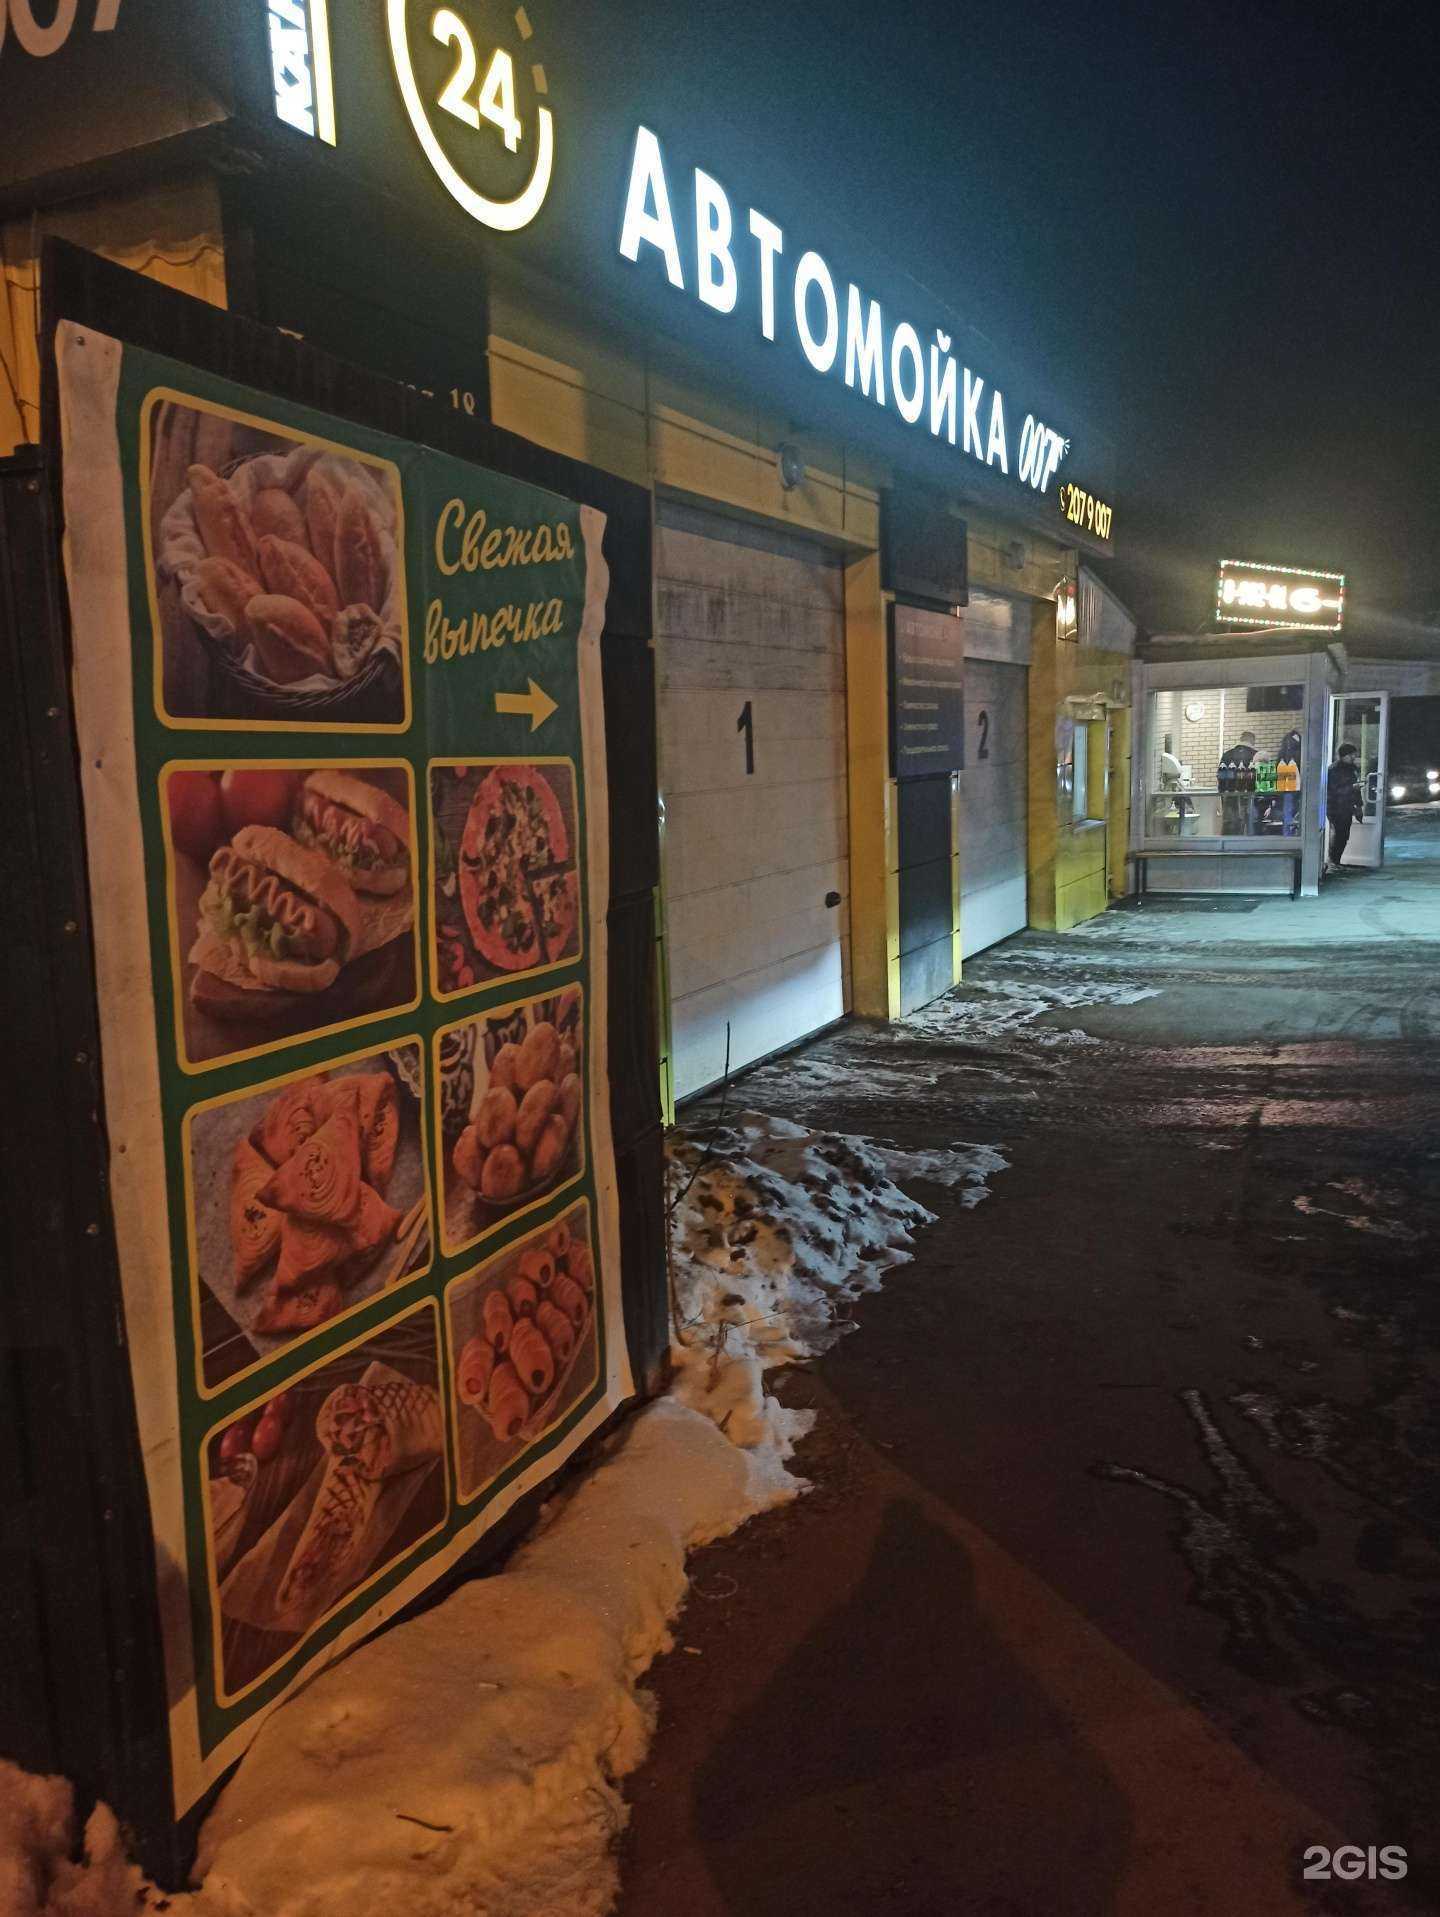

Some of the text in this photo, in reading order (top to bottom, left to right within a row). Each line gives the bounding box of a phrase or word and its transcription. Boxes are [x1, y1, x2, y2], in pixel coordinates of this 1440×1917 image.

[431, 8, 522, 154] 24
[618, 124, 1064, 494] АВТОМОЙКА 007
[434, 497, 575, 576] Свежая
[1066, 482, 1113, 540] 207 9 007
[423, 597, 564, 665] выпечка
[736, 700, 755, 775] 1
[977, 709, 990, 760] 2
